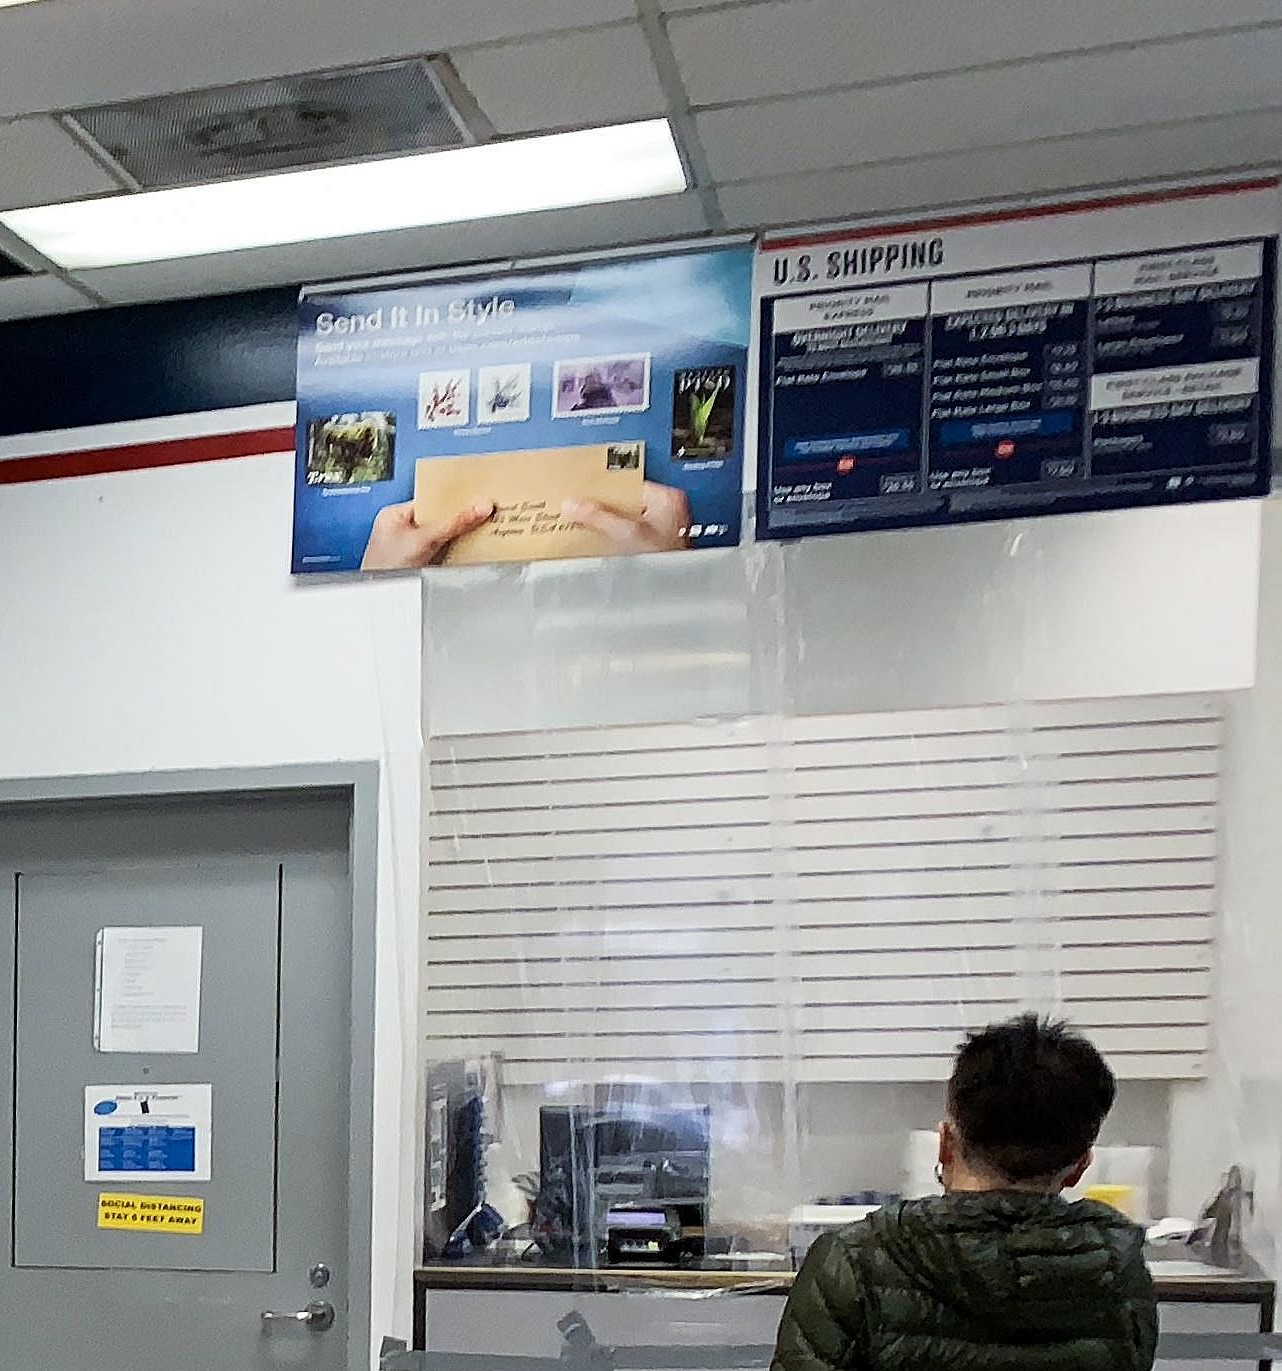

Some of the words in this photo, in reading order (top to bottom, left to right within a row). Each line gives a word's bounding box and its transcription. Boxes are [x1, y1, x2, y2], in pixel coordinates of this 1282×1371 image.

[774, 254, 819, 285] U.S.
[826, 237, 944, 280] SHIPPING
[315, 307, 383, 336] Send
[390, 305, 408, 328] It
[415, 304, 440, 326] In
[447, 296, 517, 326] Style
[101, 1199, 136, 1210] SOCIAL
[140, 1201, 202, 1213] DISTANCING
[104, 1211, 129, 1220] STAY
[140, 1214, 165, 1223] FEET
[168, 1215, 197, 1225] AWAY
